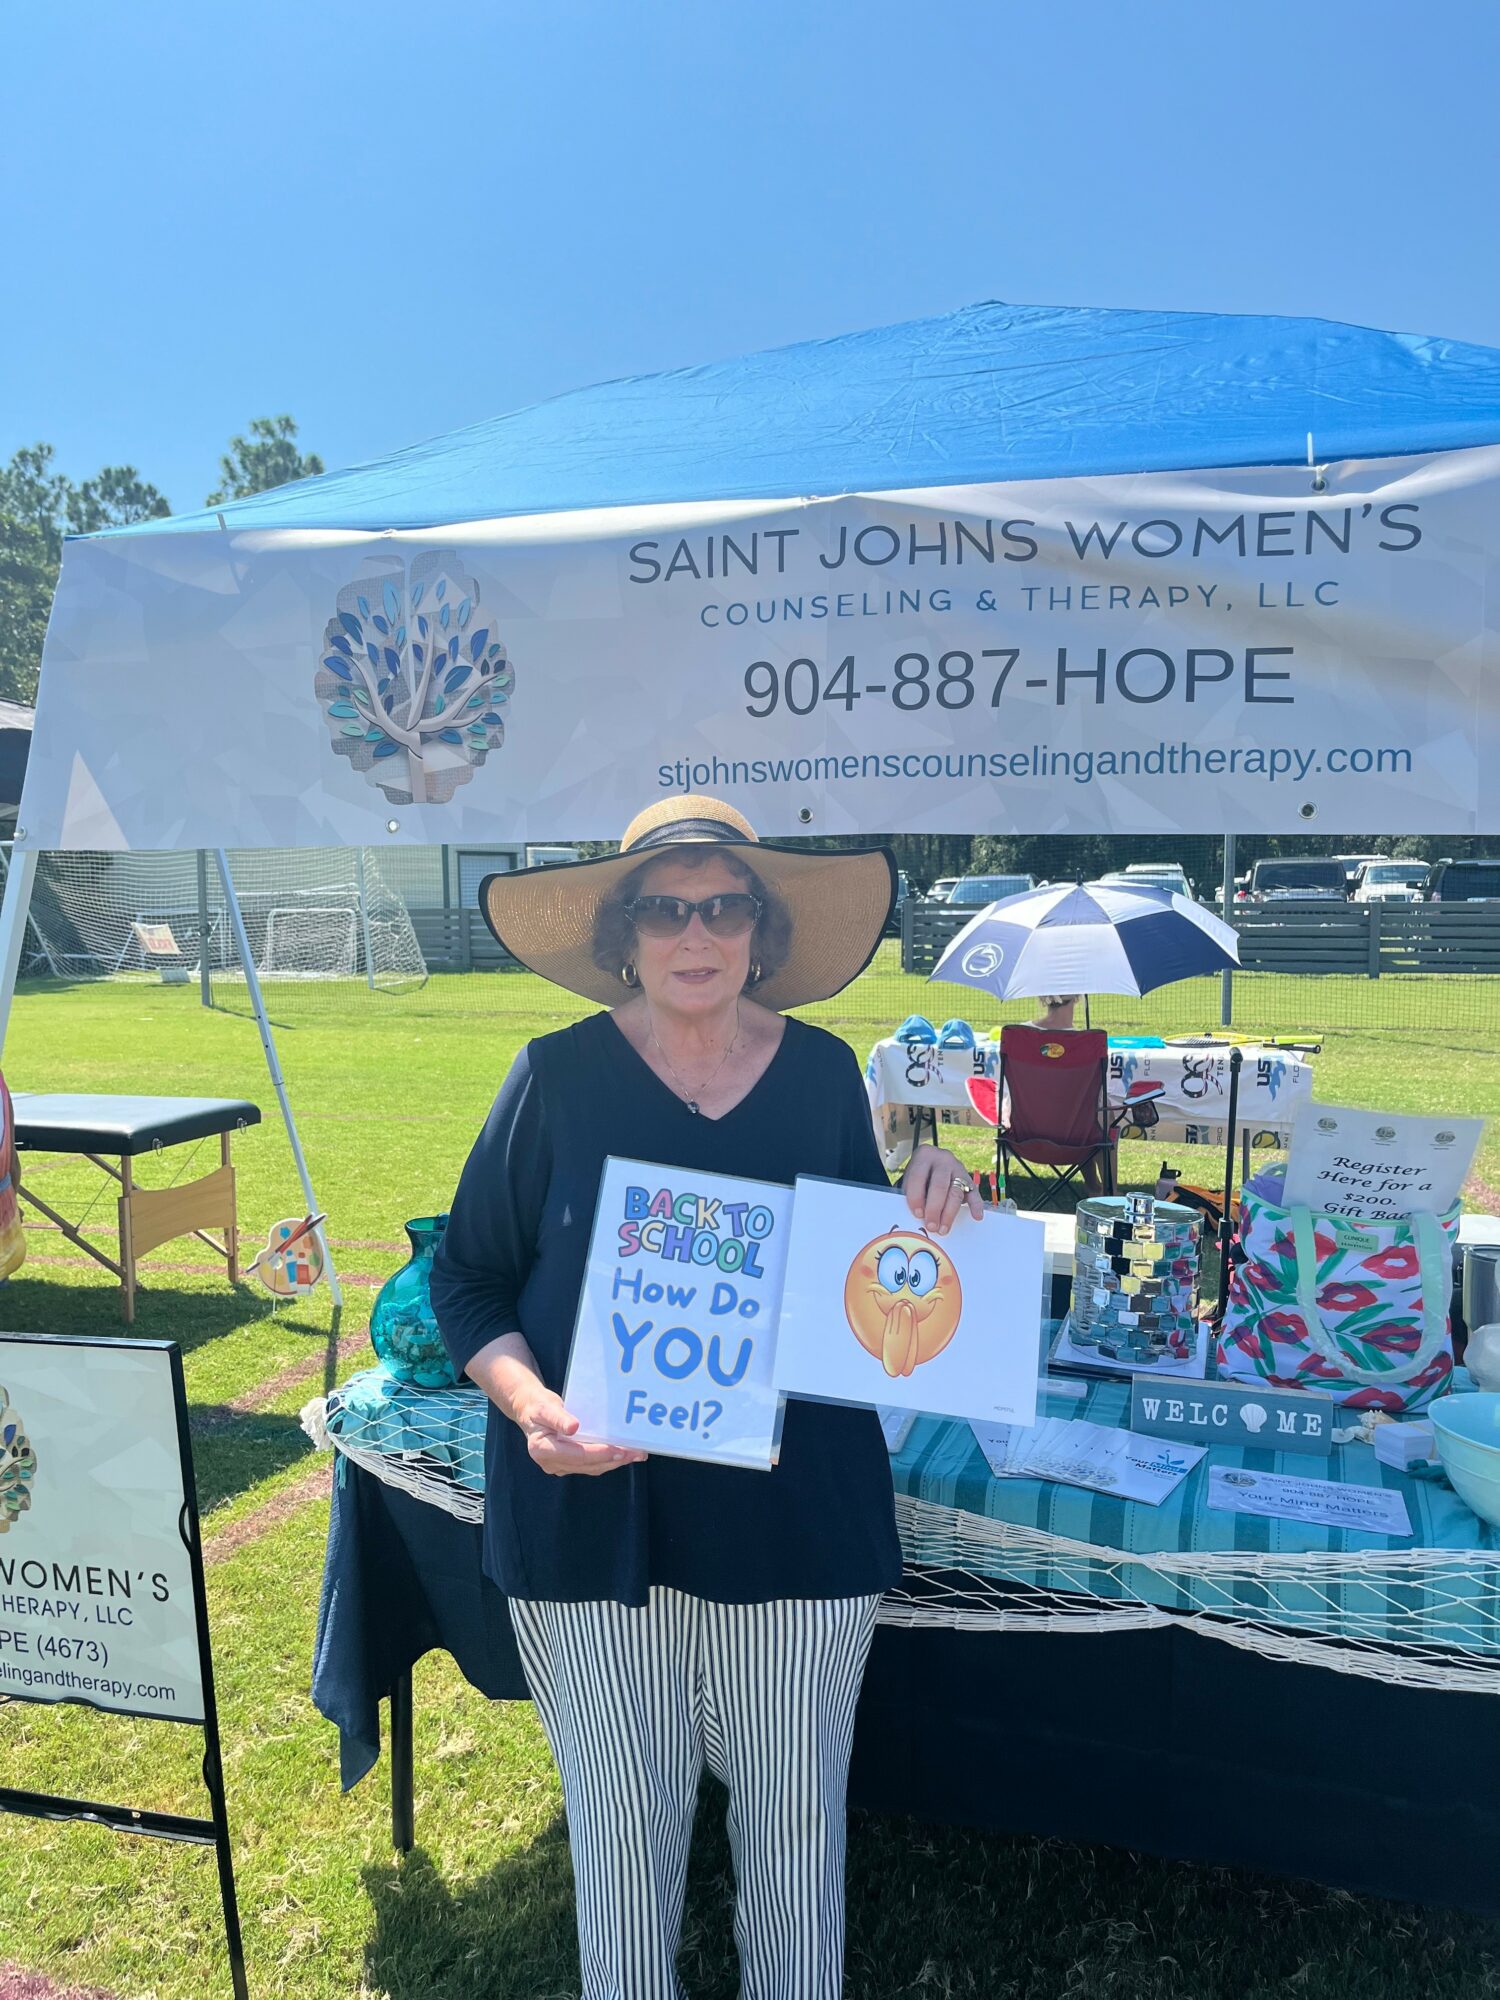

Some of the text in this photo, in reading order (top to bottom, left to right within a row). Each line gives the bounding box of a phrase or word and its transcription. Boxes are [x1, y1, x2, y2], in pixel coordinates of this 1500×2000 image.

[629, 502, 1423, 584] SAINT JOHNS WOMEN'S
[700, 580, 1340, 628] COUNSELING & THERAPY, LLC
[743, 645, 1296, 718] 904-887-HOPE
[658, 740, 1414, 794] stjohnswomenscounselingandtherapy.com
[1317, 1171, 1433, 1193] Here for a
[1333, 1156, 1427, 1176] Register
[625, 1186, 774, 1240] BACK TO
[1324, 1202, 1364, 1218] Gift
[1343, 1192, 1397, 1206] $200.
[618, 1220, 765, 1280] SCHOOL
[611, 1266, 761, 1320] How Do
[609, 1310, 754, 1388] YOU
[624, 1389, 724, 1440] Feel?
[1238, 1490, 1275, 1503] Your
[1280, 1497, 1319, 1509] Mind
[1325, 1503, 1389, 1519] Matters
[96, 1604, 133, 1626] LLC
[37, 1634, 109, 1669] (4673)
